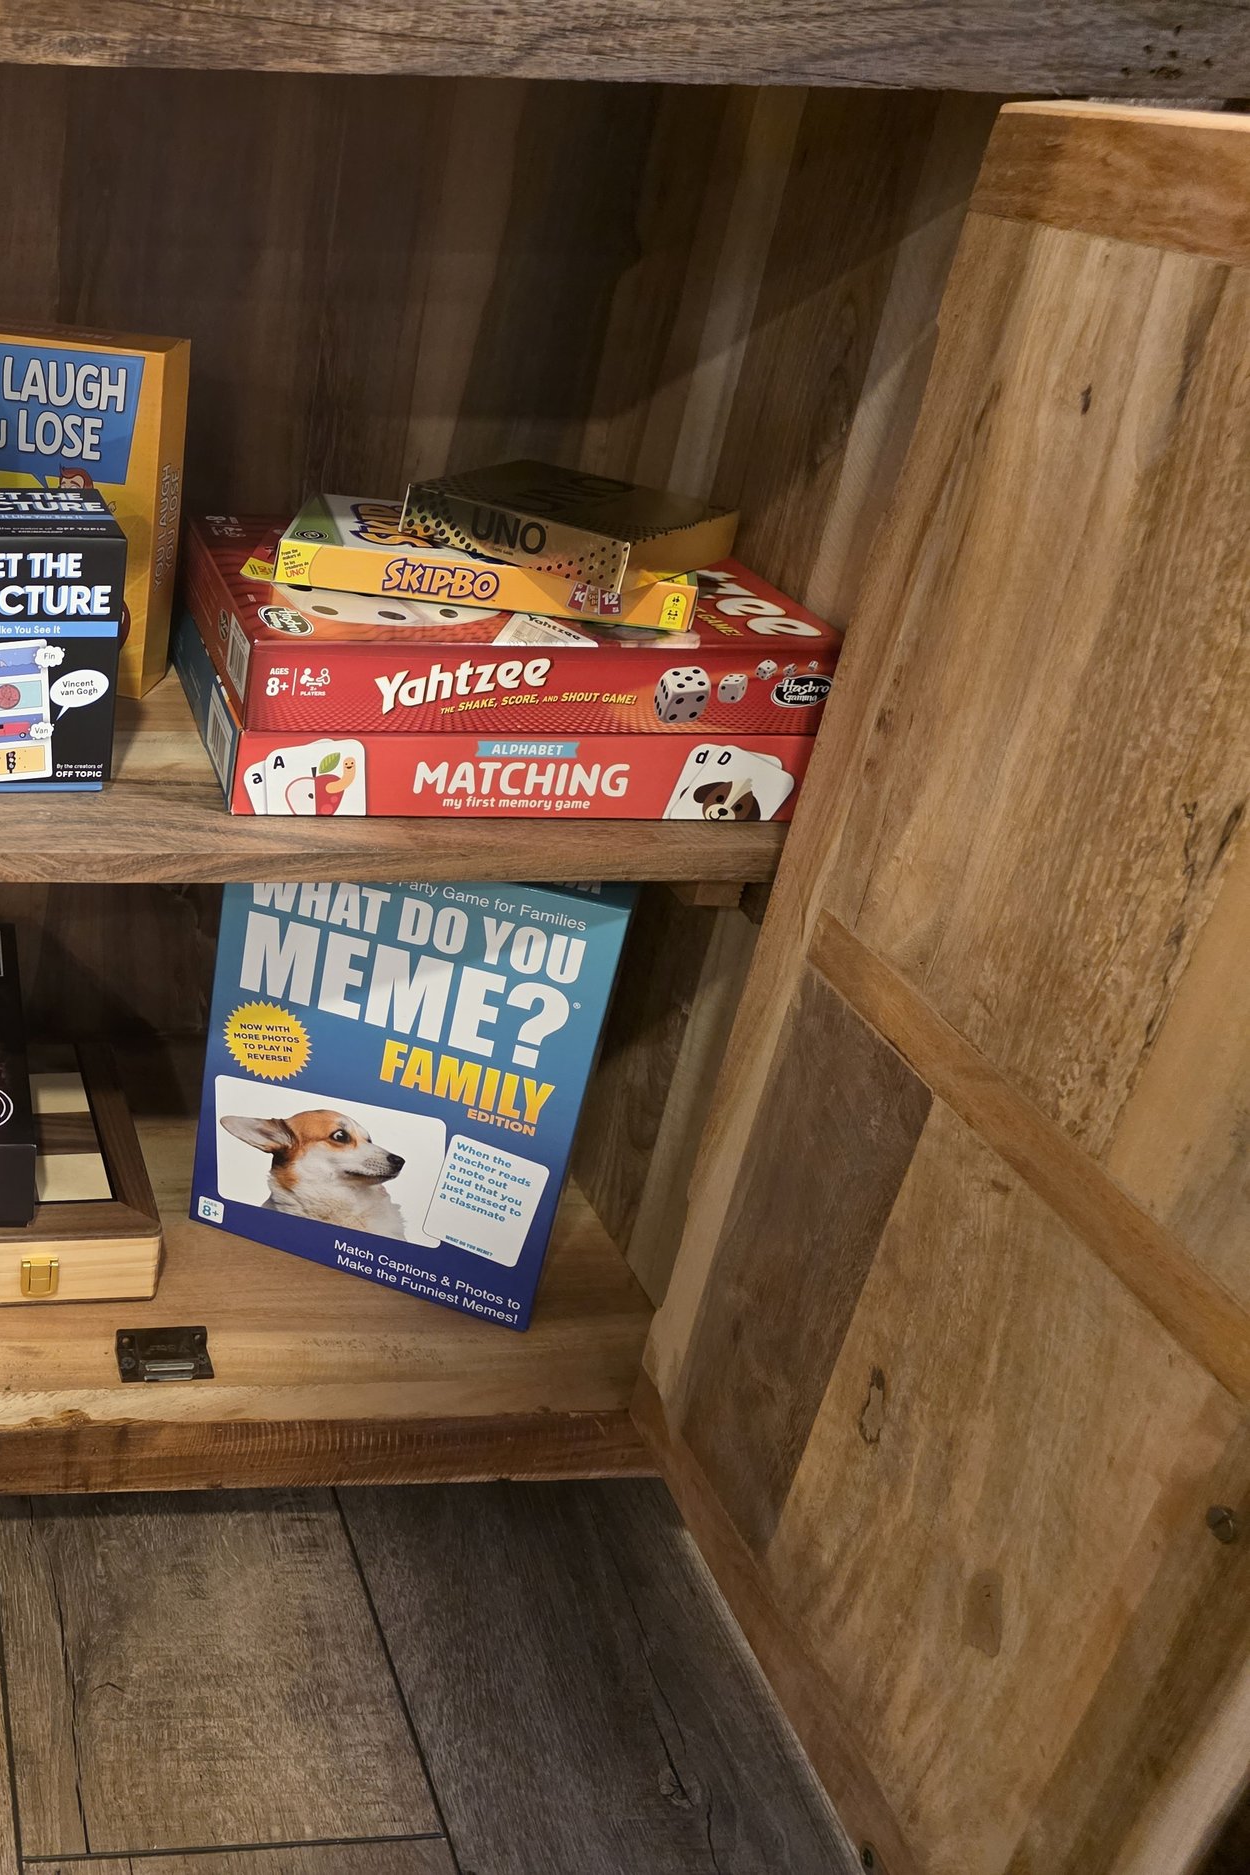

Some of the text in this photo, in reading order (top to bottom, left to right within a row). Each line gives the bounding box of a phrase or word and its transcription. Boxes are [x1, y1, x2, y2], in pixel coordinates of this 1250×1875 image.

[2, 356, 128, 413] LAUGH
[17, 408, 103, 461] LOSE
[26, 492, 84, 502] THE
[153, 463, 171, 592] YOU LAUGH
[164, 467, 180, 575] YOU LOSE
[470, 507, 547, 554] UNO
[27, 553, 83, 579] THE
[285, 568, 305, 578] UNO
[601, 592, 619, 605] 12
[14, 625, 32, 635] You
[33, 625, 51, 635] See
[53, 626, 61, 635] It
[526, 614, 581, 641] Yahtzee
[697, 614, 745, 637] GAME!
[43, 653, 56, 661] Fin
[269, 667, 289, 675] AGES
[60, 687, 99, 697] van Gogh
[62, 679, 94, 688] Vincent
[265, 677, 289, 697] 8+
[374, 657, 551, 715] Yahtzee
[782, 679, 830, 694] Hasbro
[440, 692, 637, 714] THE SHAKE, SCORE, AND SHOUT GAME!
[783, 691, 818, 705] Gaming
[34, 726, 49, 735] Van
[491, 744, 564, 756] ALPHABET
[696, 750, 710, 764] d
[717, 751, 732, 765] D
[273, 755, 286, 770] A
[251, 772, 263, 785] a
[412, 761, 630, 797] MATCHING
[442, 796, 591, 811] my first memory game
[443, 886, 490, 909] Game
[494, 894, 517, 913] for
[519, 903, 587, 932] Families
[251, 882, 587, 984] WHAT DO YOU
[239, 910, 570, 1070] MEME?
[233, 1032, 300, 1044] MORE PHOTOS
[239, 1023, 290, 1033] NOW WITH
[243, 1042, 293, 1053] TO PLAY IN
[247, 1053, 292, 1063] REVERSE!
[379, 1038, 556, 1125] FAMILY
[467, 1108, 536, 1137] EDITION
[457, 1142, 512, 1168] When the
[453, 1152, 531, 1187] teacher reads
[459, 1166, 485, 1181] note
[488, 1178, 508, 1190] out
[442, 1181, 522, 1217] just passed to
[446, 1172, 523, 1206] loud that you
[202, 1204, 219, 1217] 8+
[449, 1196, 506, 1222] classmate
[334, 1239, 521, 1310] Match Captions & Photos to
[337, 1254, 518, 1325] Make the Funniest Memes!
